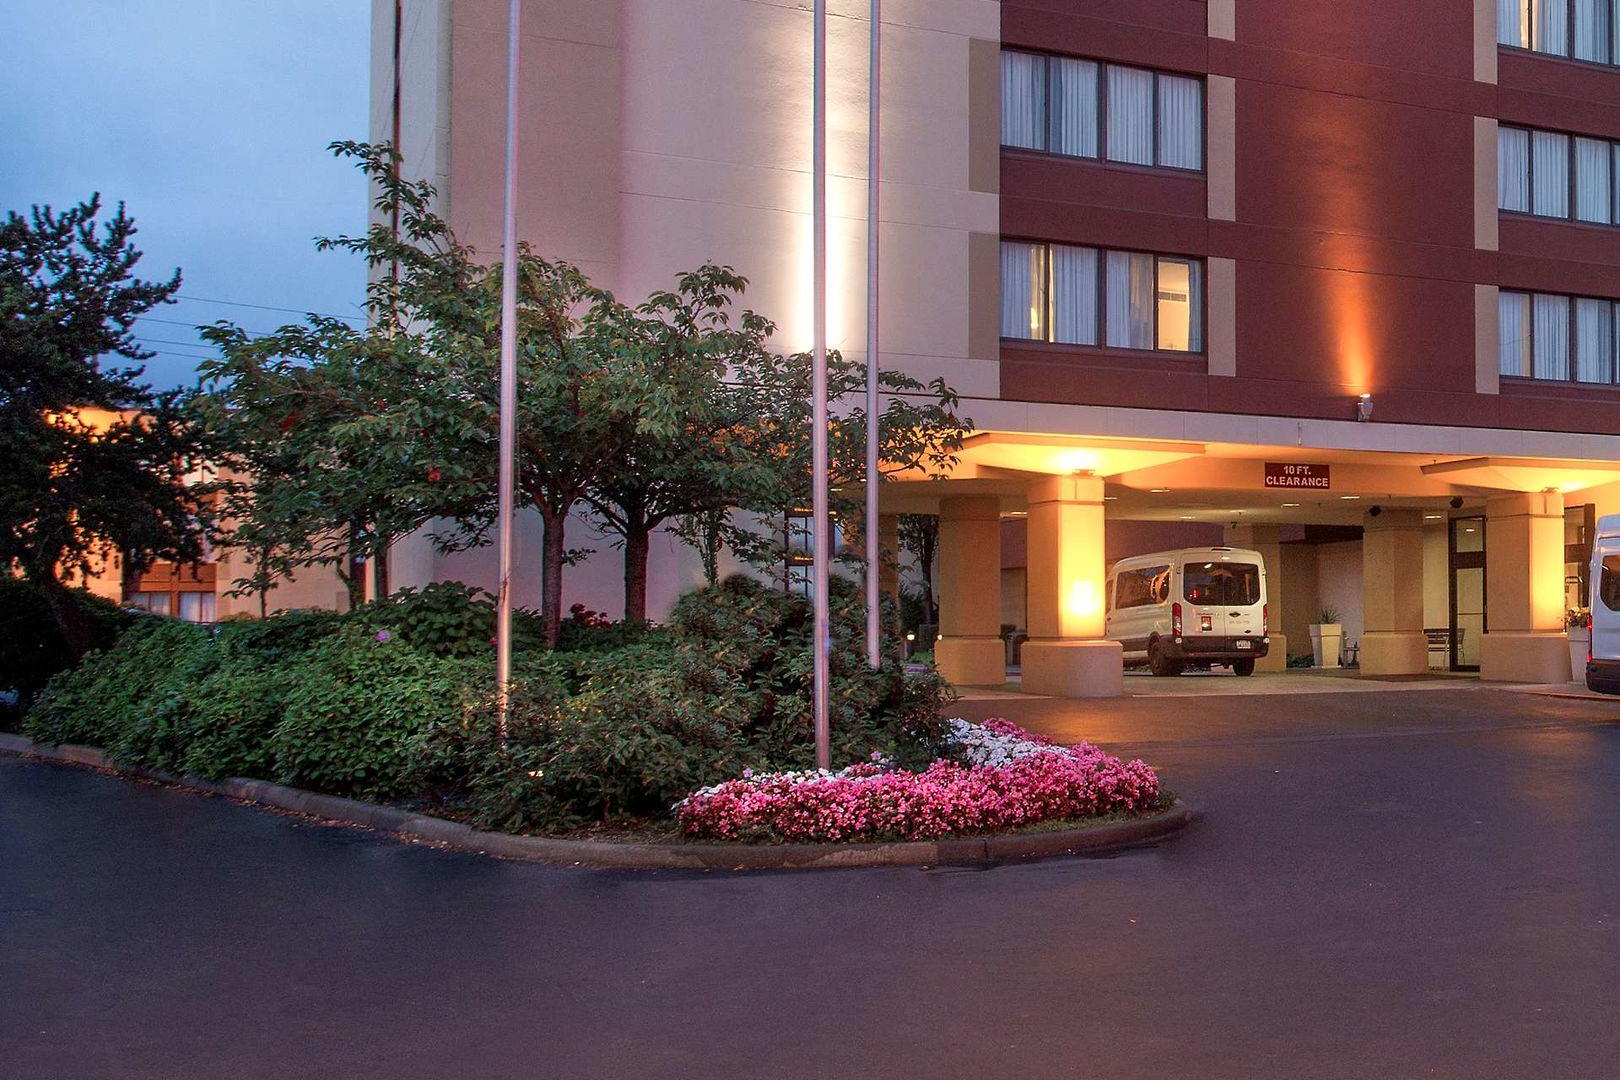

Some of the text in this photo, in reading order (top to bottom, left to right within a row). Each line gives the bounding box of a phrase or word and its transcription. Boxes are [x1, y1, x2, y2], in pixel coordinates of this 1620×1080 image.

[1284, 465, 1311, 475] 10 FT.
[1266, 476, 1328, 486] CLEARANCE
